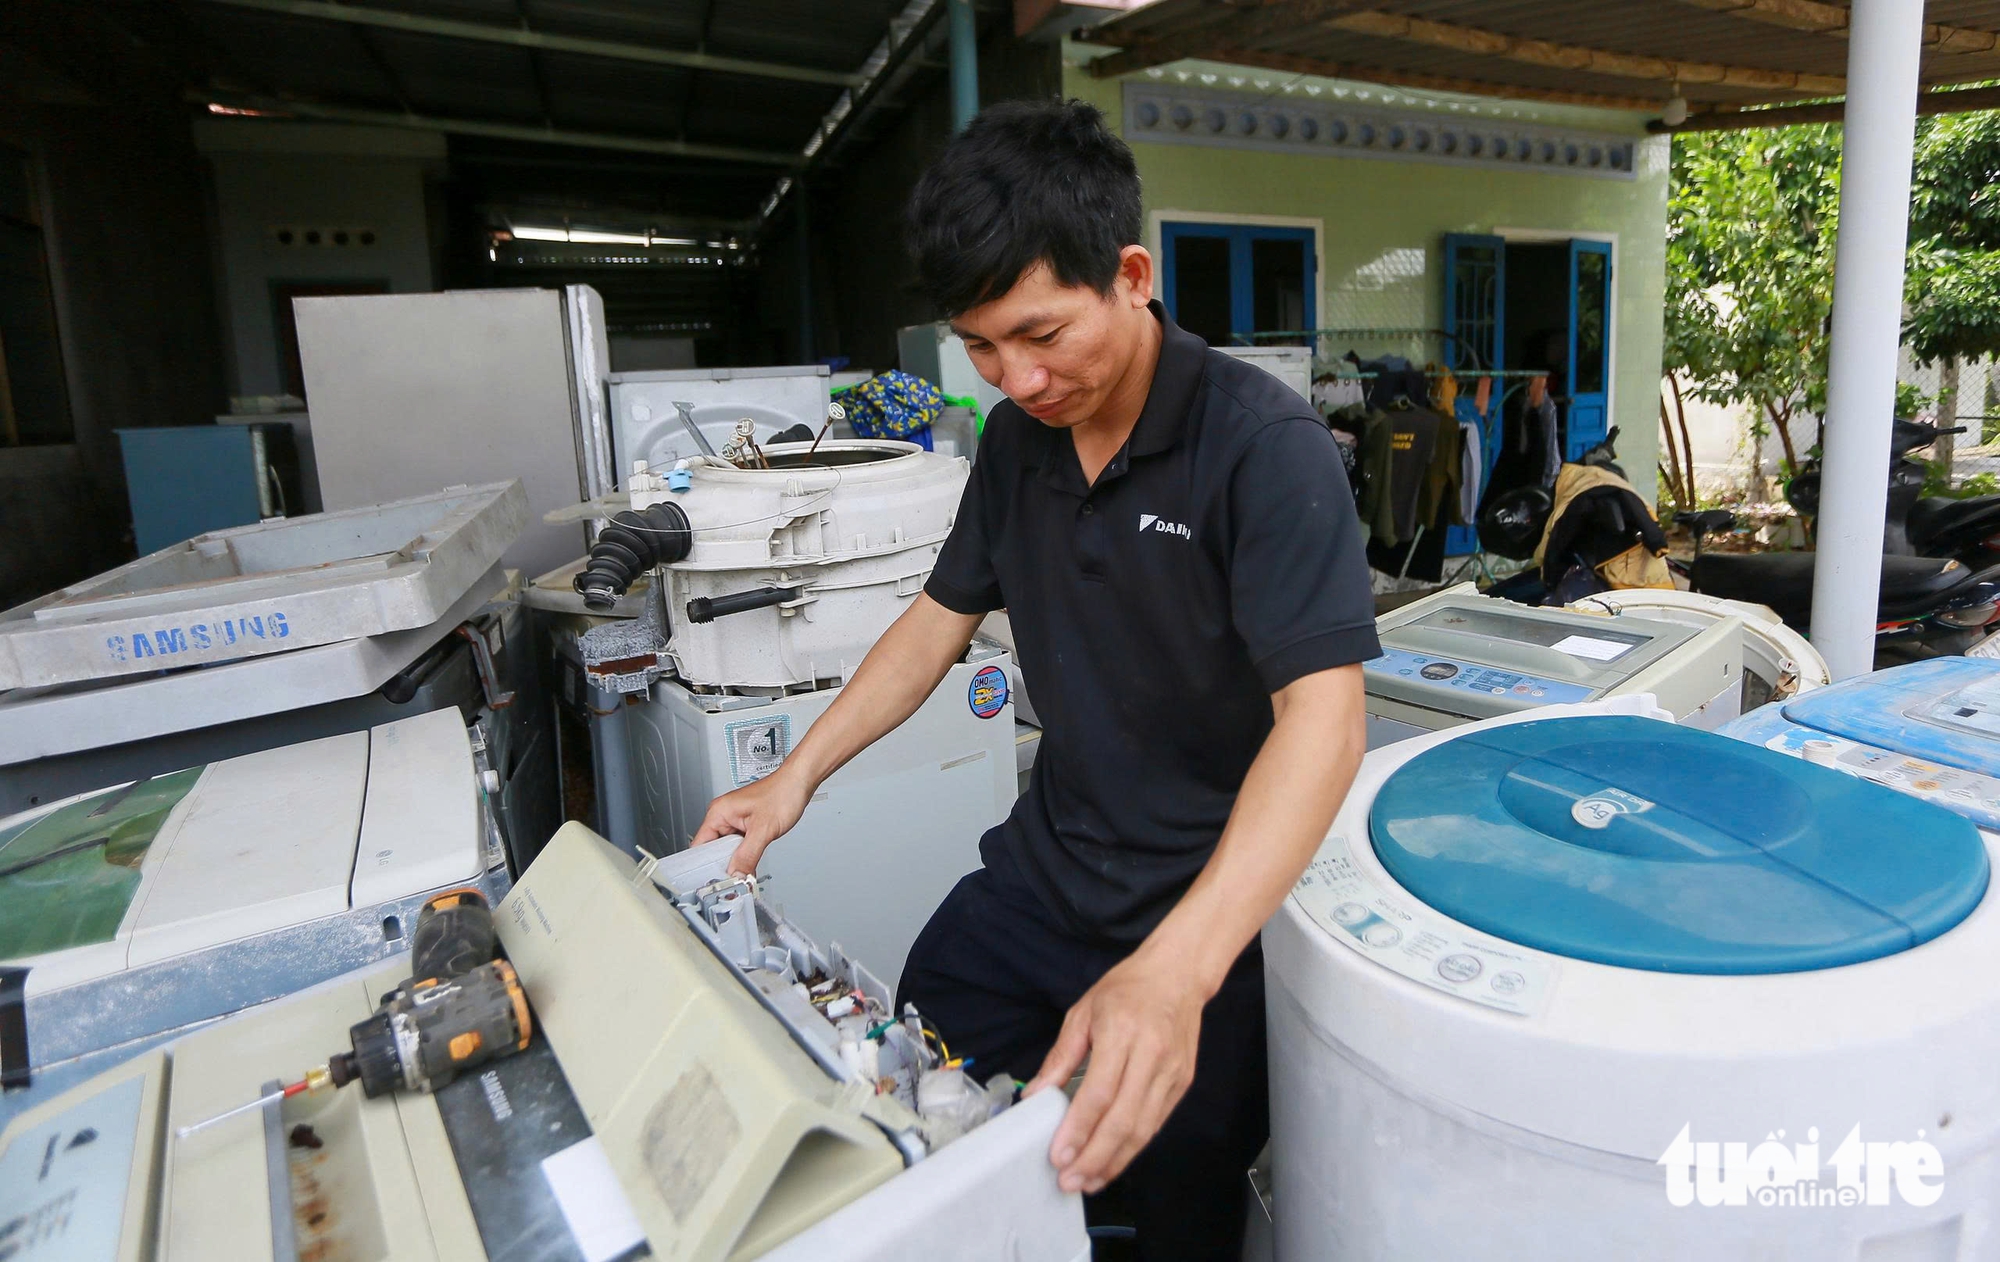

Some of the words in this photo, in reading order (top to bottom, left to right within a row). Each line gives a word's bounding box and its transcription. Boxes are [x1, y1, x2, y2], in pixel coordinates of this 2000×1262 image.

[107, 612, 290, 661] SAMSUNG
[975, 676, 989, 688] OMO
[764, 727, 776, 755] 1
[480, 1070, 513, 1120] SAMSUNG
